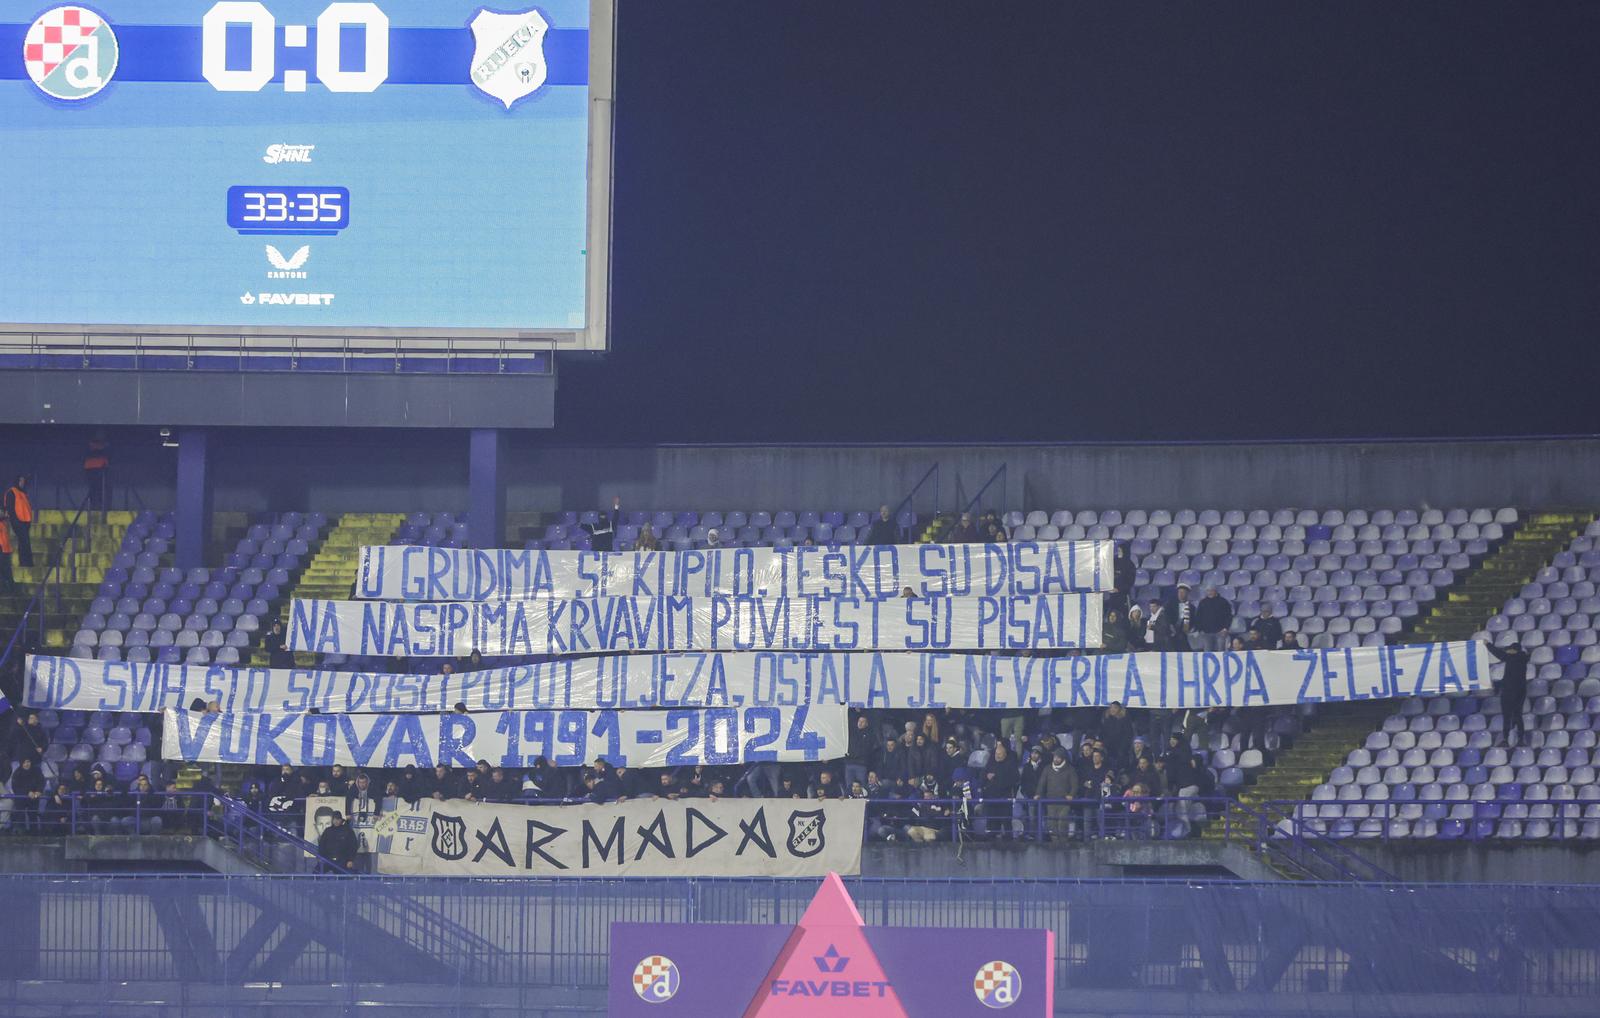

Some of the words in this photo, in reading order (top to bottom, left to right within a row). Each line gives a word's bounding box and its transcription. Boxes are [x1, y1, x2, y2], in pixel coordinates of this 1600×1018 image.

[202, 1, 388, 92] 0:0
[243, 193, 342, 222] 33:35
[259, 293, 335, 305] FAVBET
[362, 545, 385, 598] U
[401, 547, 554, 600] GRUDIMA
[576, 550, 623, 599] SE
[773, 544, 900, 599] TEŠKO
[919, 544, 972, 597] SU
[984, 540, 1100, 596] DISALI
[290, 600, 341, 653] NA
[361, 602, 533, 656] NASIPIMA
[548, 595, 692, 653] KRVAVIM
[711, 596, 887, 650] POVIJEST
[905, 597, 952, 648] SU
[978, 592, 1086, 648] PISALI
[29, 655, 81, 709] OD
[98, 660, 188, 712] SVIH
[283, 669, 336, 712] SU
[461, 659, 577, 709] POPUT
[753, 652, 890, 708] OSTALA
[907, 653, 950, 708] JE
[965, 654, 1146, 708] NEVJERICA
[1159, 652, 1167, 708] I
[1178, 651, 1269, 707] HRPA
[176, 708, 477, 769] VUKOVAR
[495, 704, 826, 768] 1991-2024
[472, 807, 776, 869] ARMADA
[771, 979, 892, 997] FAVBET
